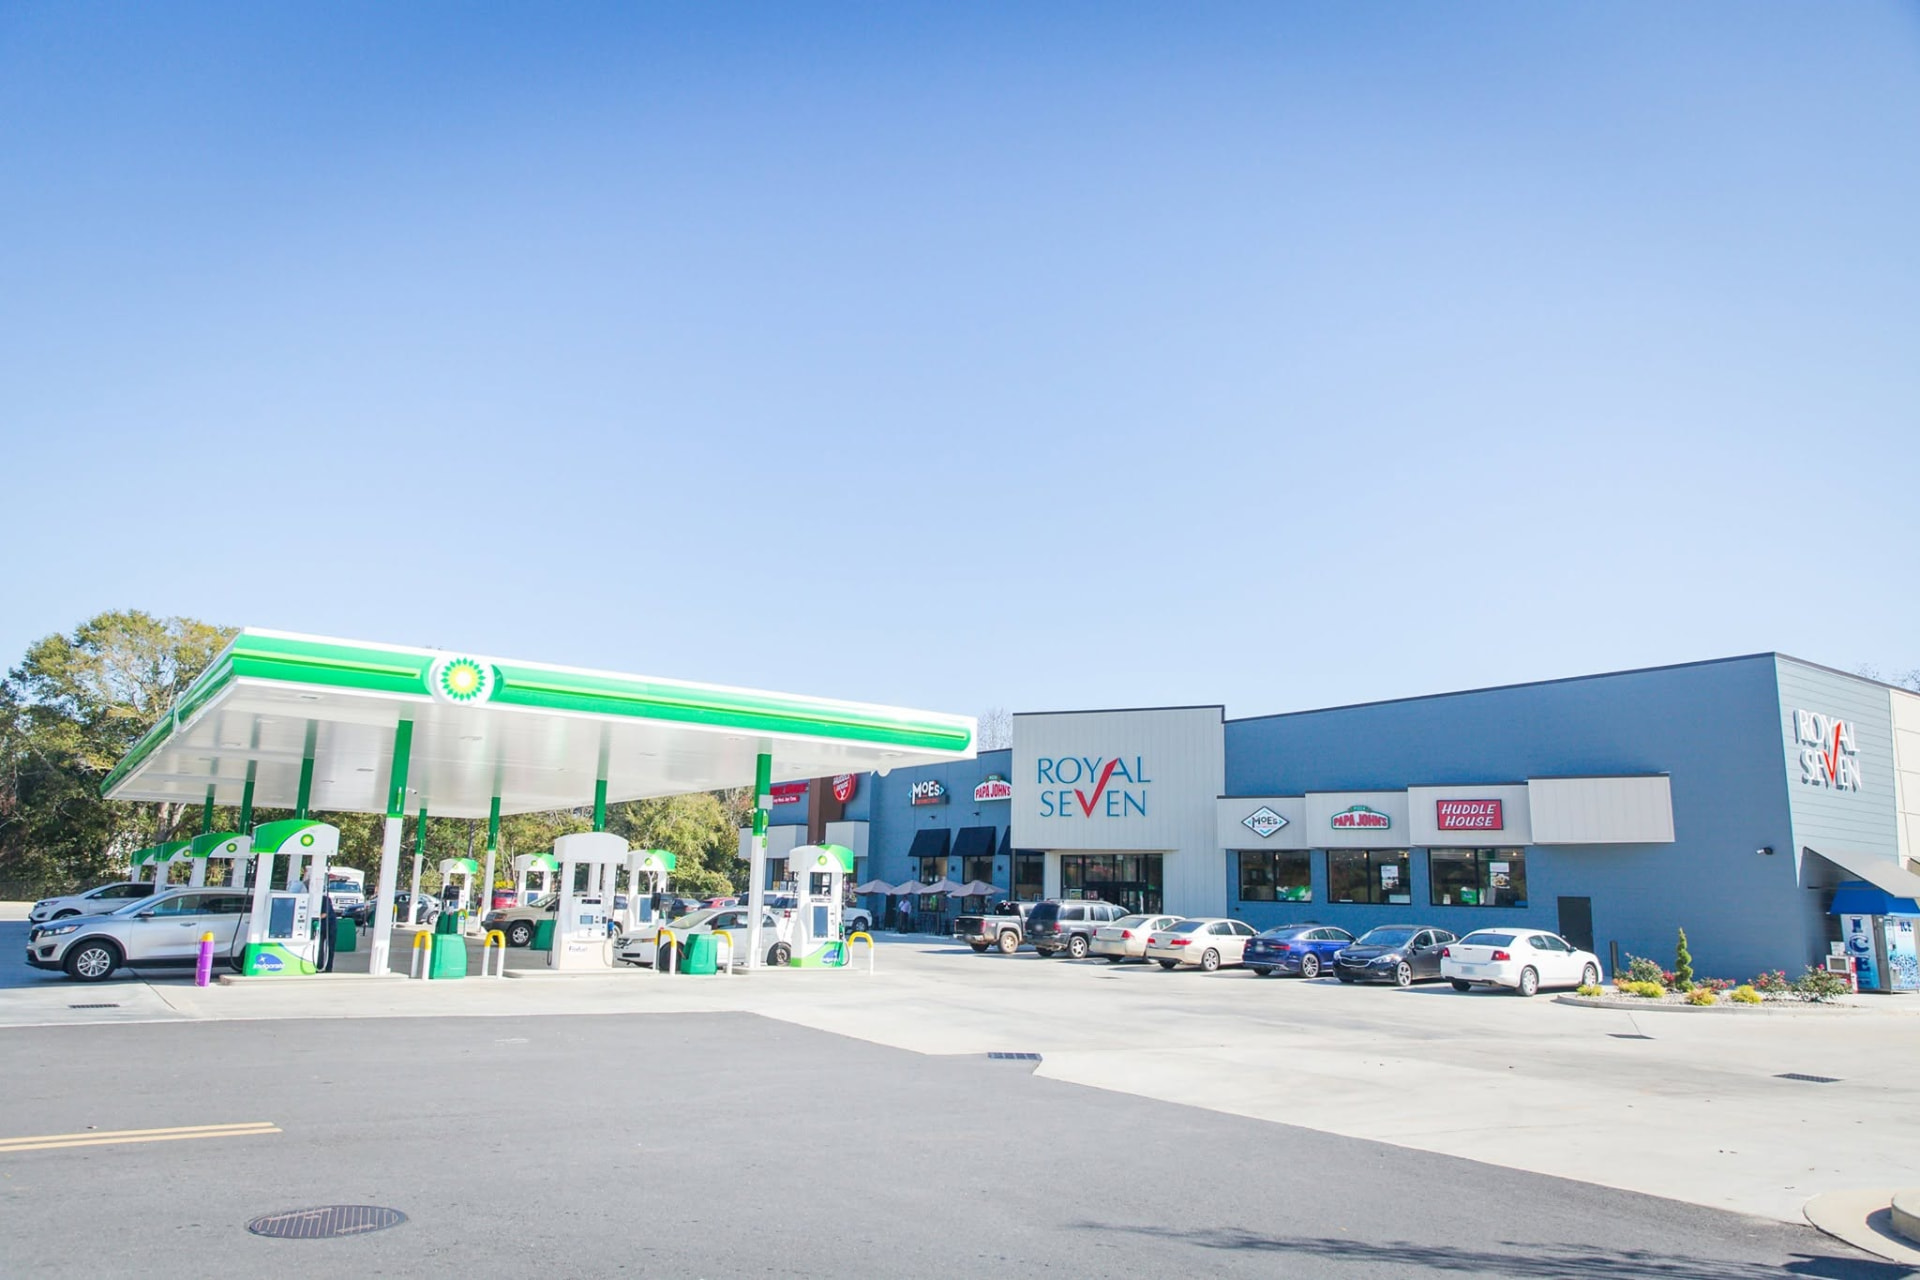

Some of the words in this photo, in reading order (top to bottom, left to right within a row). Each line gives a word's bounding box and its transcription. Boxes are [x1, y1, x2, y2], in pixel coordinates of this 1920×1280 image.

[1797, 709, 1861, 754] ROYAL
[1037, 756, 1151, 784] ROYAL
[1801, 748, 1862, 790] SEVEN
[975, 785, 989, 799] PAPA
[990, 783, 1011, 797] JOHN'S
[1039, 788, 1146, 819] SEVEN
[1333, 814, 1356, 827] PAPA
[1357, 813, 1387, 827] JOHN'S
[1441, 804, 1496, 815] HUDDLE
[1445, 816, 1494, 827] HOUSE
[1849, 916, 1872, 972] ICE
